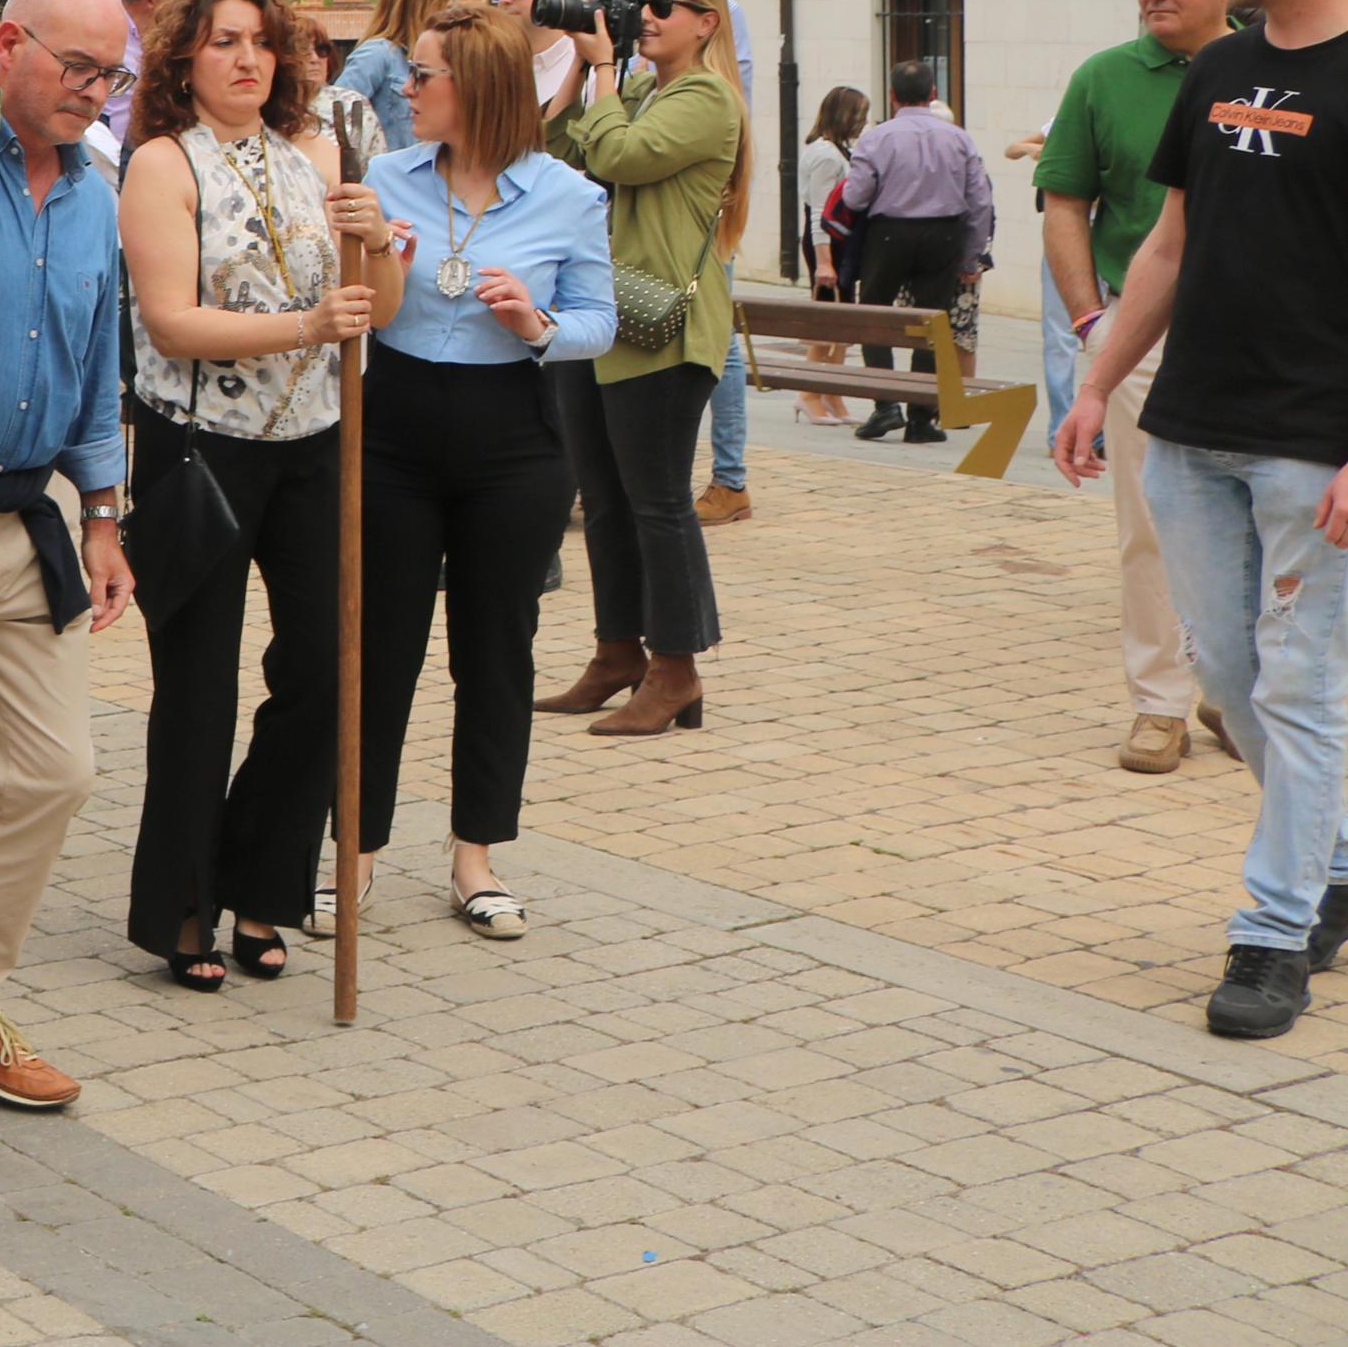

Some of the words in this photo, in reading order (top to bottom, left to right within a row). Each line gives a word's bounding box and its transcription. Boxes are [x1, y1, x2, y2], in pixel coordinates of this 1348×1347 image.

[1211, 105, 1243, 120] Calvin
[1244, 110, 1270, 125] Klein
[1271, 114, 1306, 131] Jeans
